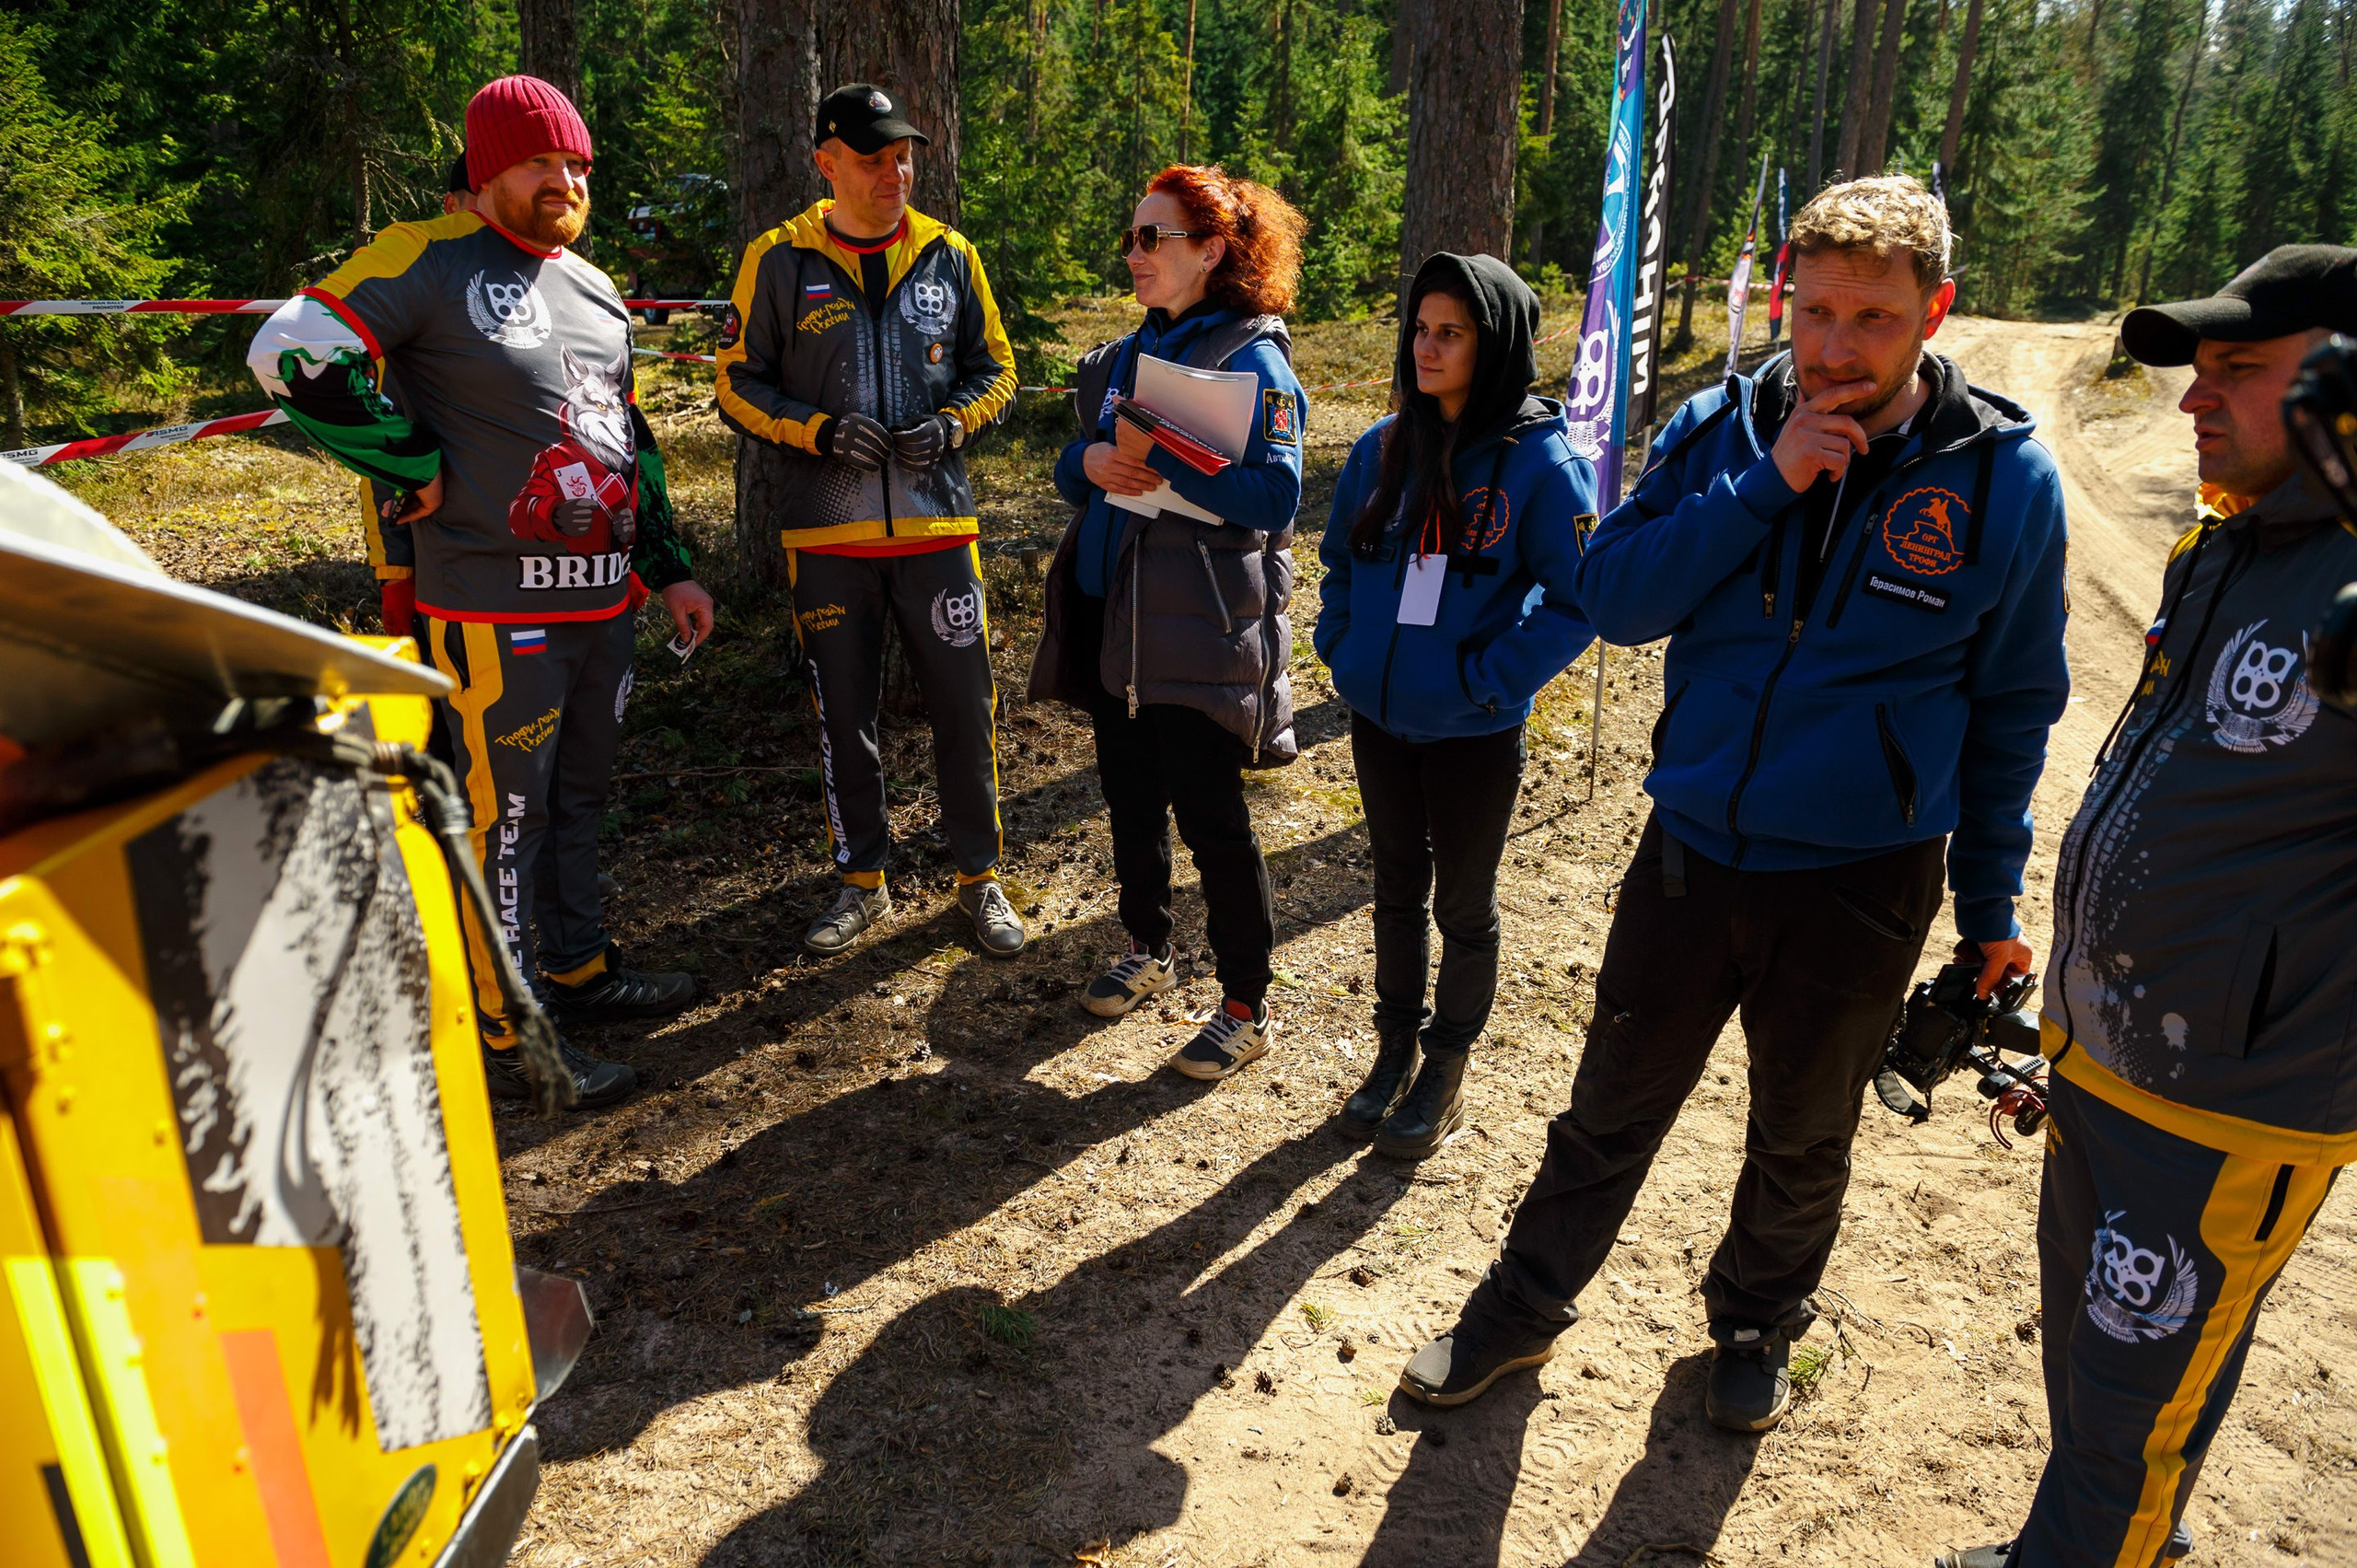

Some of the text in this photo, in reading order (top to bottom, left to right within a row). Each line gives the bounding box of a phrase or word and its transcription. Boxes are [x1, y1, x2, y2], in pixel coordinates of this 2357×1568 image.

[1922, 533, 1940, 544] ОРГ
[1899, 540, 1951, 562] ЛЕНИНГРАД
[1909, 552, 1937, 568] ТРОФИ
[1869, 575, 1945, 608] Герасимов Роман
[497, 792, 527, 944] RACE TEAM
